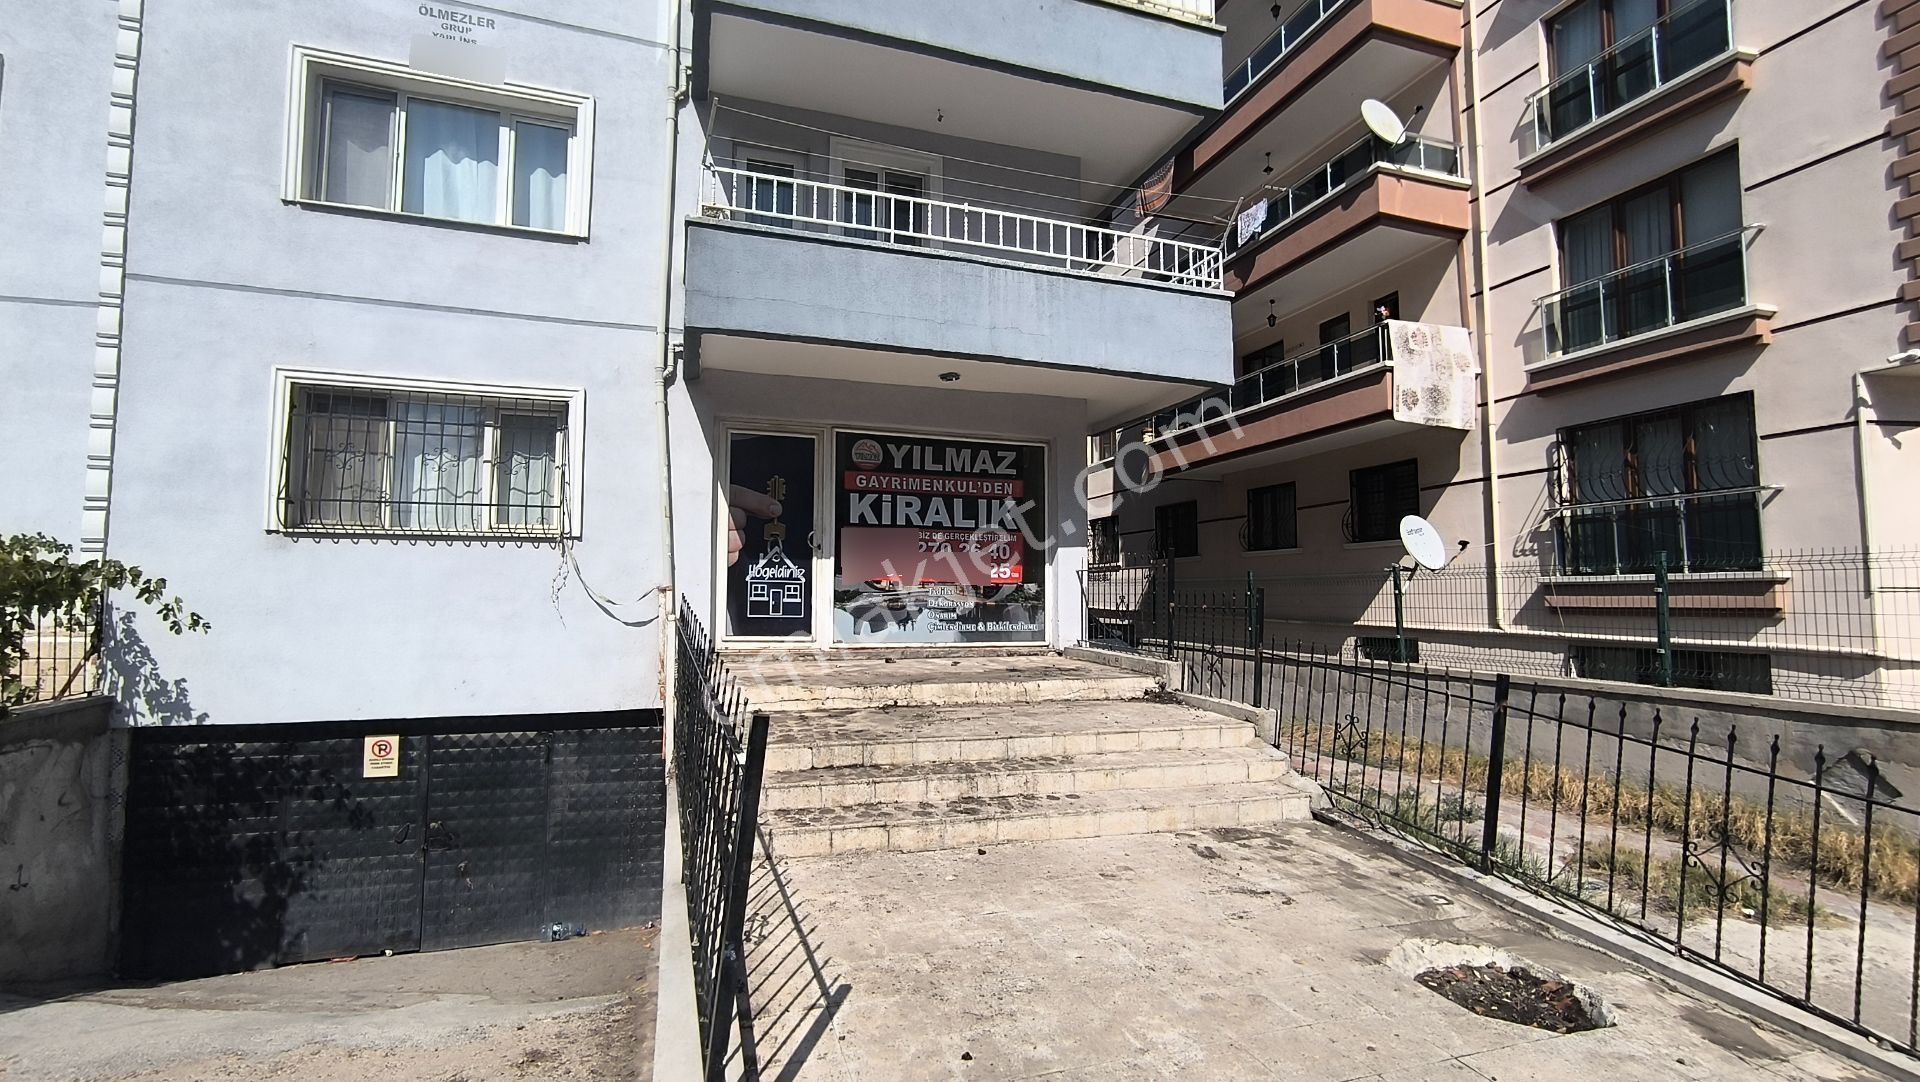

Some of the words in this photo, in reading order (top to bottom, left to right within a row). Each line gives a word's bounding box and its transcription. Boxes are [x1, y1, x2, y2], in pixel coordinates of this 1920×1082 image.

[418, 3, 495, 30] ÖLMEZLER
[441, 22, 472, 34] GRUP
[886, 443, 1017, 475] YILMAZ
[977, 622, 985, 631] &
